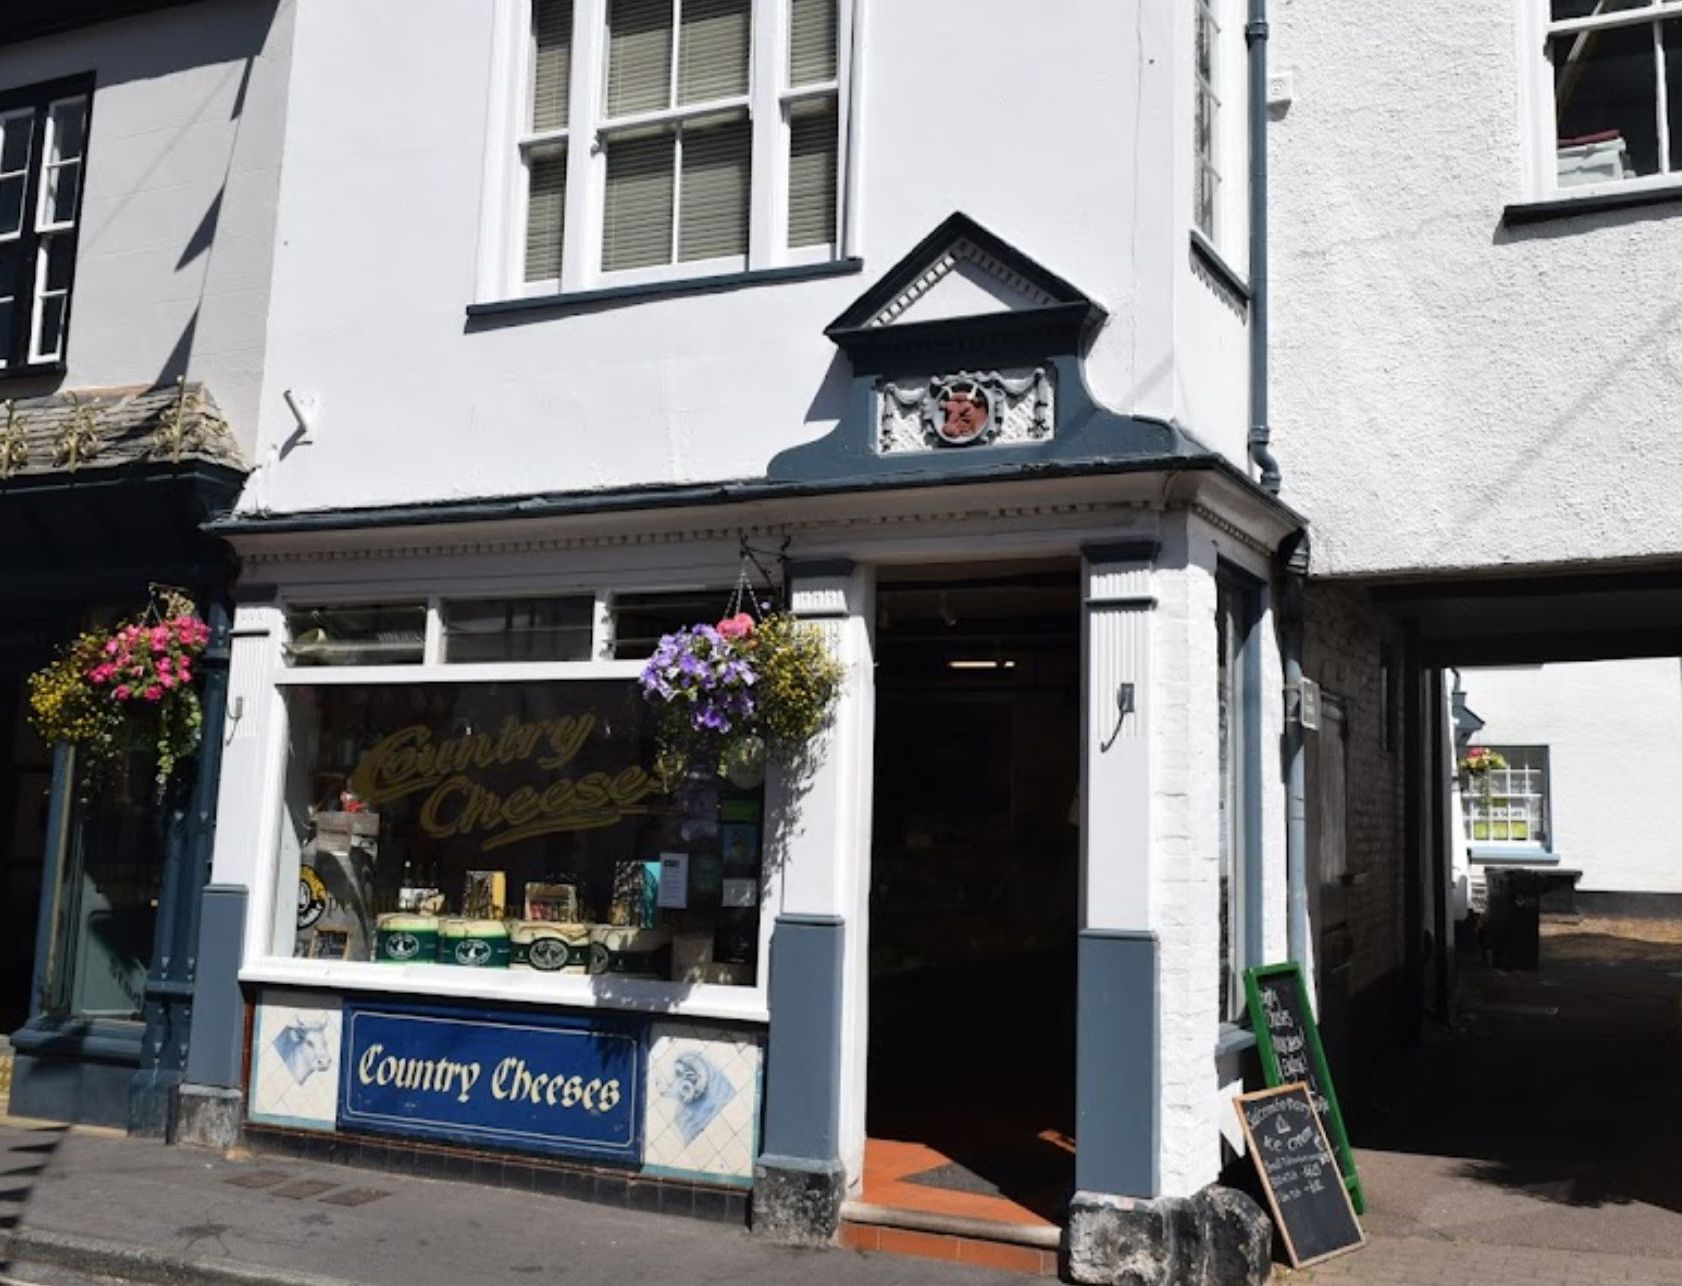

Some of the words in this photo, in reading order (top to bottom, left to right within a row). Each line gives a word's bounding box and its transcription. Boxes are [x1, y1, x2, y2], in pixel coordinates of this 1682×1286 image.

[351, 709, 597, 803] Country
[358, 1042, 481, 1104] Country
[491, 1056, 621, 1112] Cheeses
